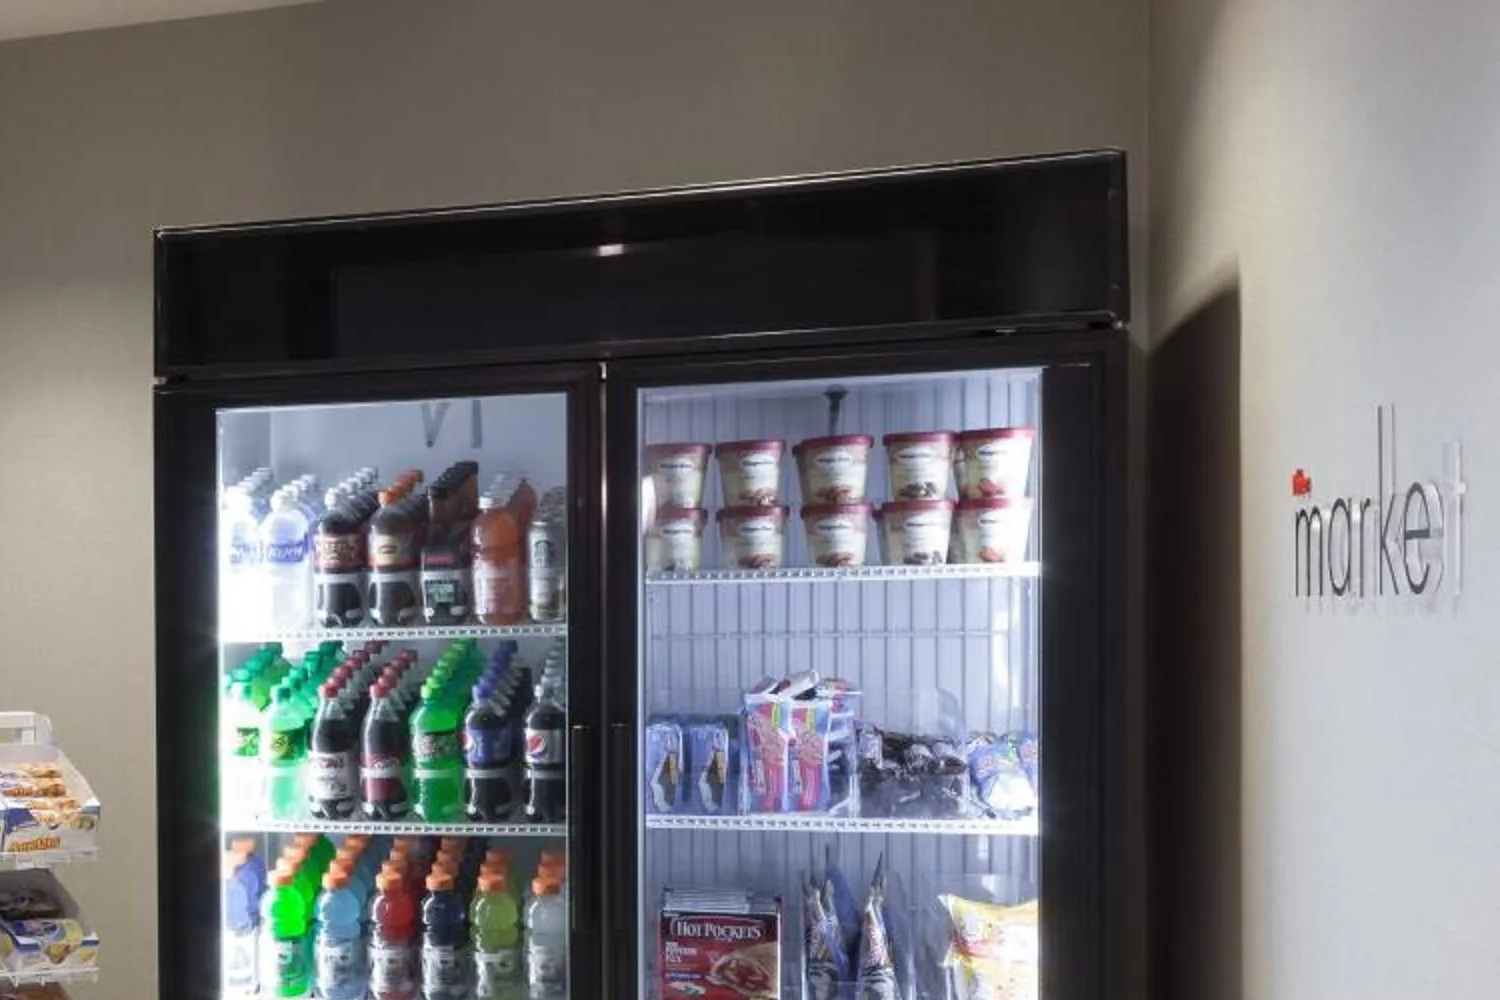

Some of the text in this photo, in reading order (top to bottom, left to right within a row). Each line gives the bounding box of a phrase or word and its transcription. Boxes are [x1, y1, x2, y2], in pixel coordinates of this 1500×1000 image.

[1295, 404, 1467, 598] market
[676, 921, 762, 939] HOT POCKETS
